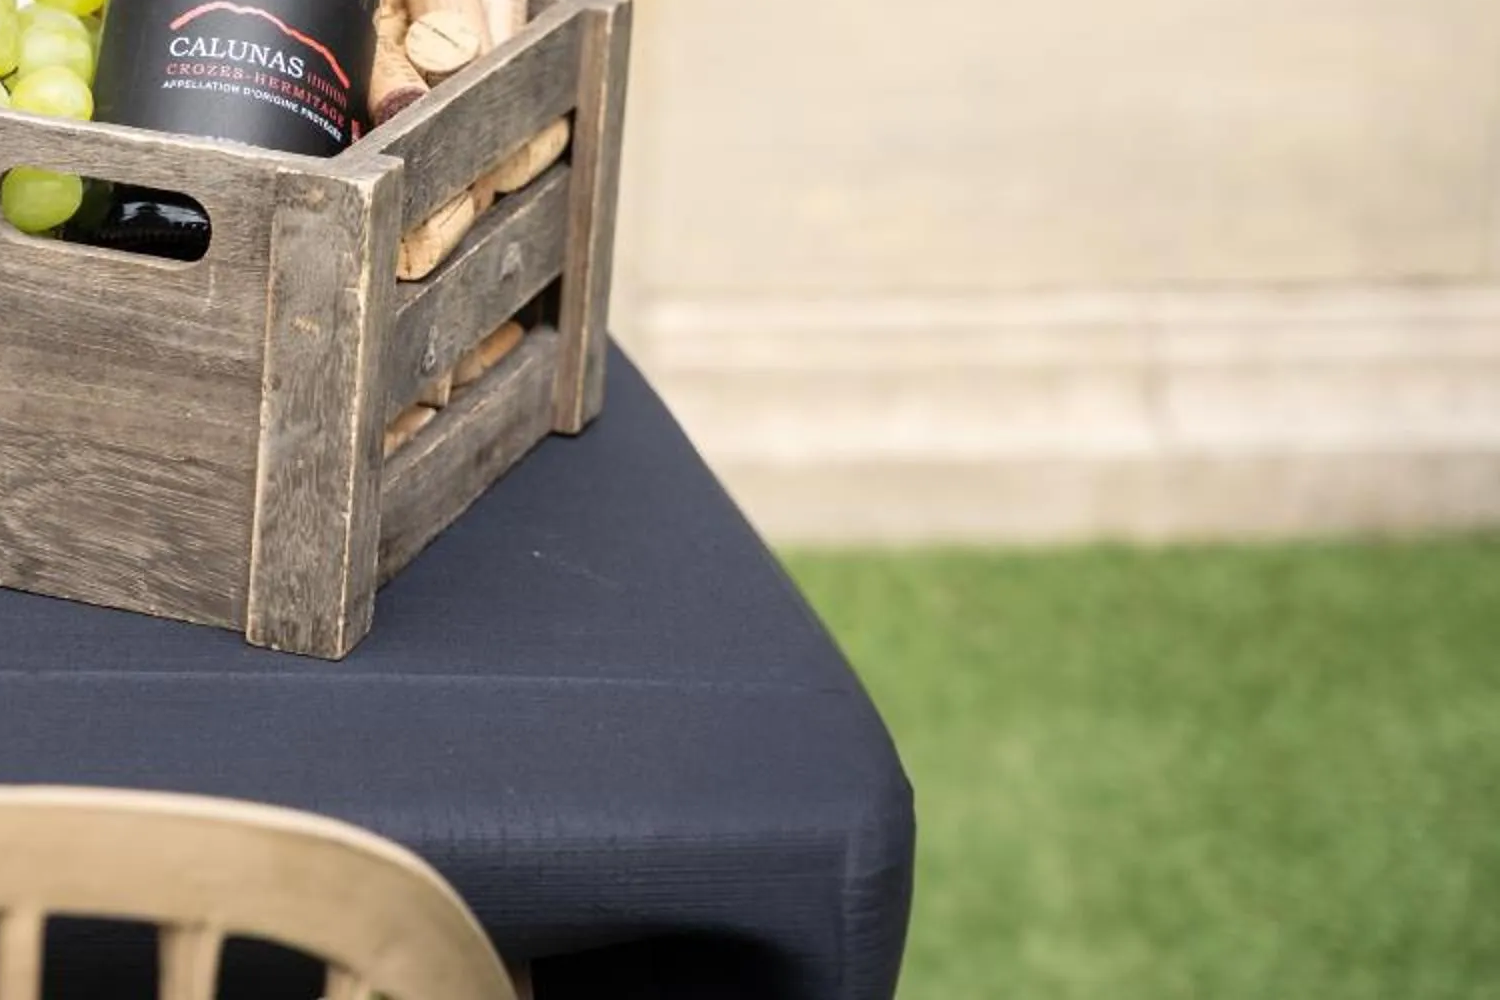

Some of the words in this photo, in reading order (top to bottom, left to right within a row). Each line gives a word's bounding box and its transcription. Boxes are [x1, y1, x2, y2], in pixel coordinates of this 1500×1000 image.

[169, 36, 304, 79] CALUNAS
[161, 79, 240, 93] APPELLATION
[166, 63, 345, 127] CROZES-HERMITAGE
